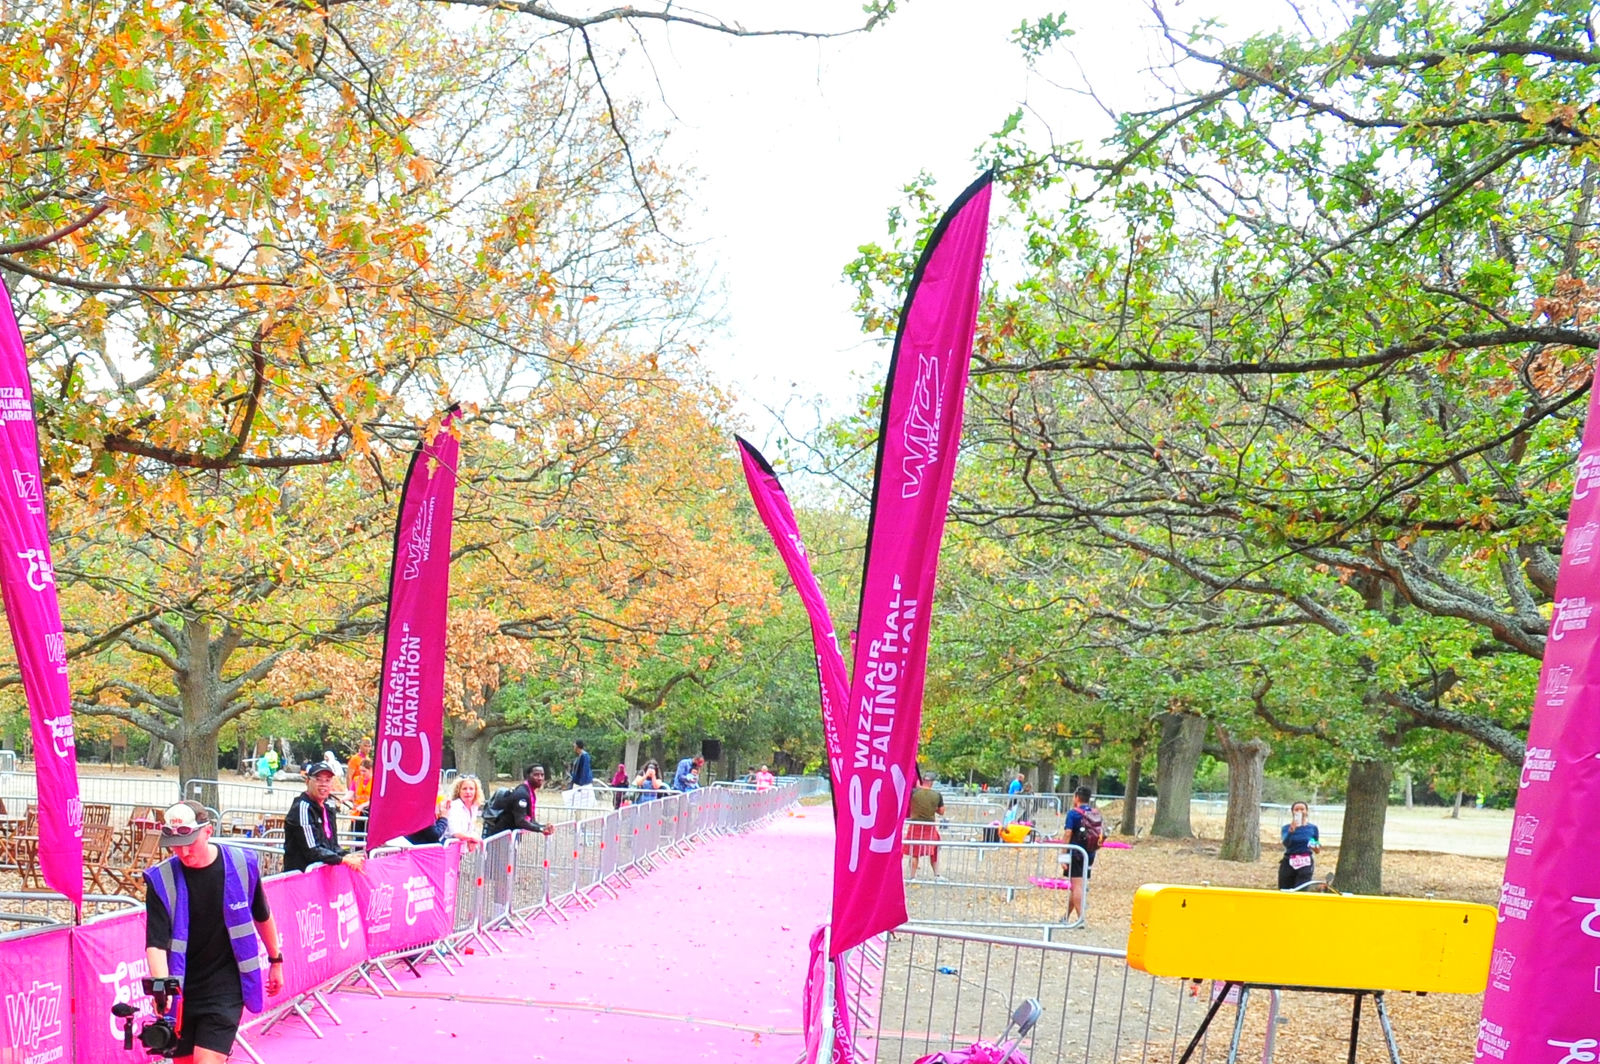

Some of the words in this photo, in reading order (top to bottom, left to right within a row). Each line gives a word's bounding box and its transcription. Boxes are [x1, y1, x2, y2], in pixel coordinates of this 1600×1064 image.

[398, 623, 410, 668] HALF
[882, 574, 902, 653] HALF
[385, 694, 394, 736] WIZZ
[390, 660, 399, 689] AIR
[392, 673, 405, 737] EALING
[404, 636, 421, 737] MARATHON
[854, 696, 873, 768] WIZZ
[864, 639, 882, 690] AIR
